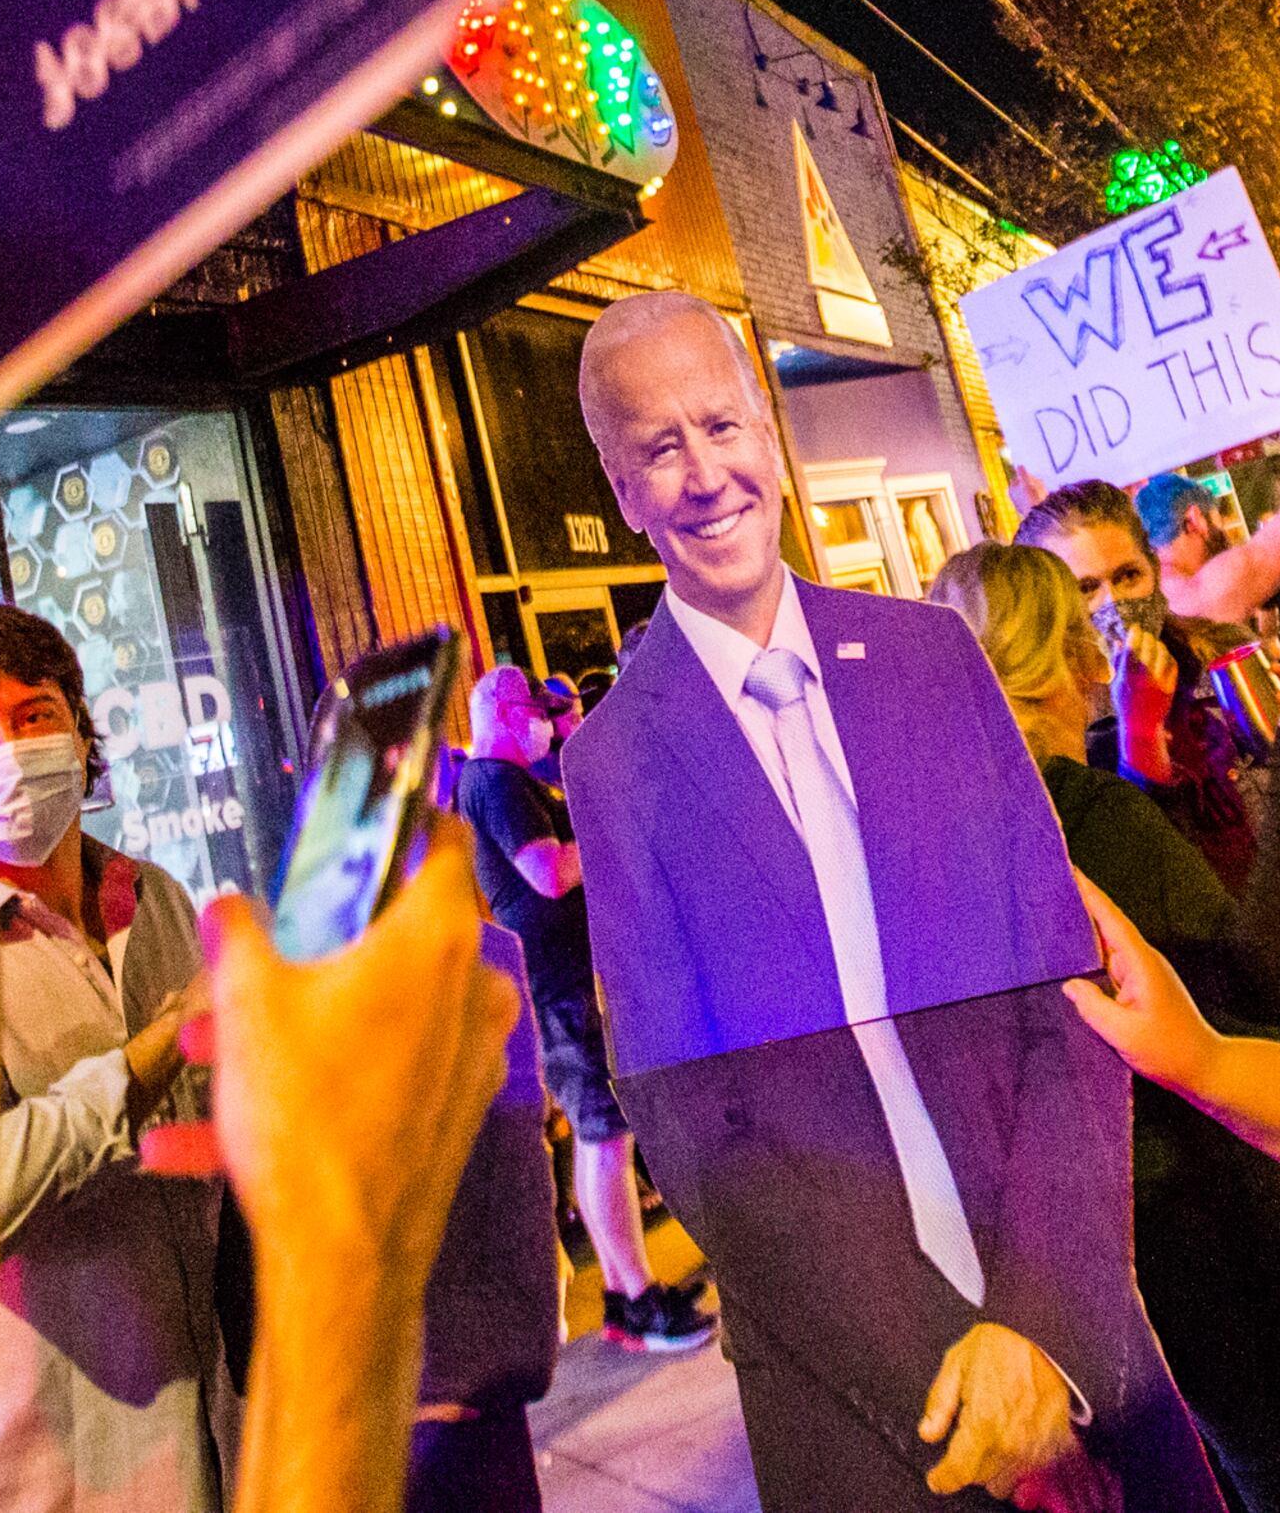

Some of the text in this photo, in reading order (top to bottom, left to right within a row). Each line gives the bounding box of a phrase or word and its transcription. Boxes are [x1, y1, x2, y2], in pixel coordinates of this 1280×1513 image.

[1021, 205, 1214, 369] WE
[1035, 385, 1132, 474] DID
[93, 675, 232, 759] CBD
[122, 794, 246, 853] Smoke
